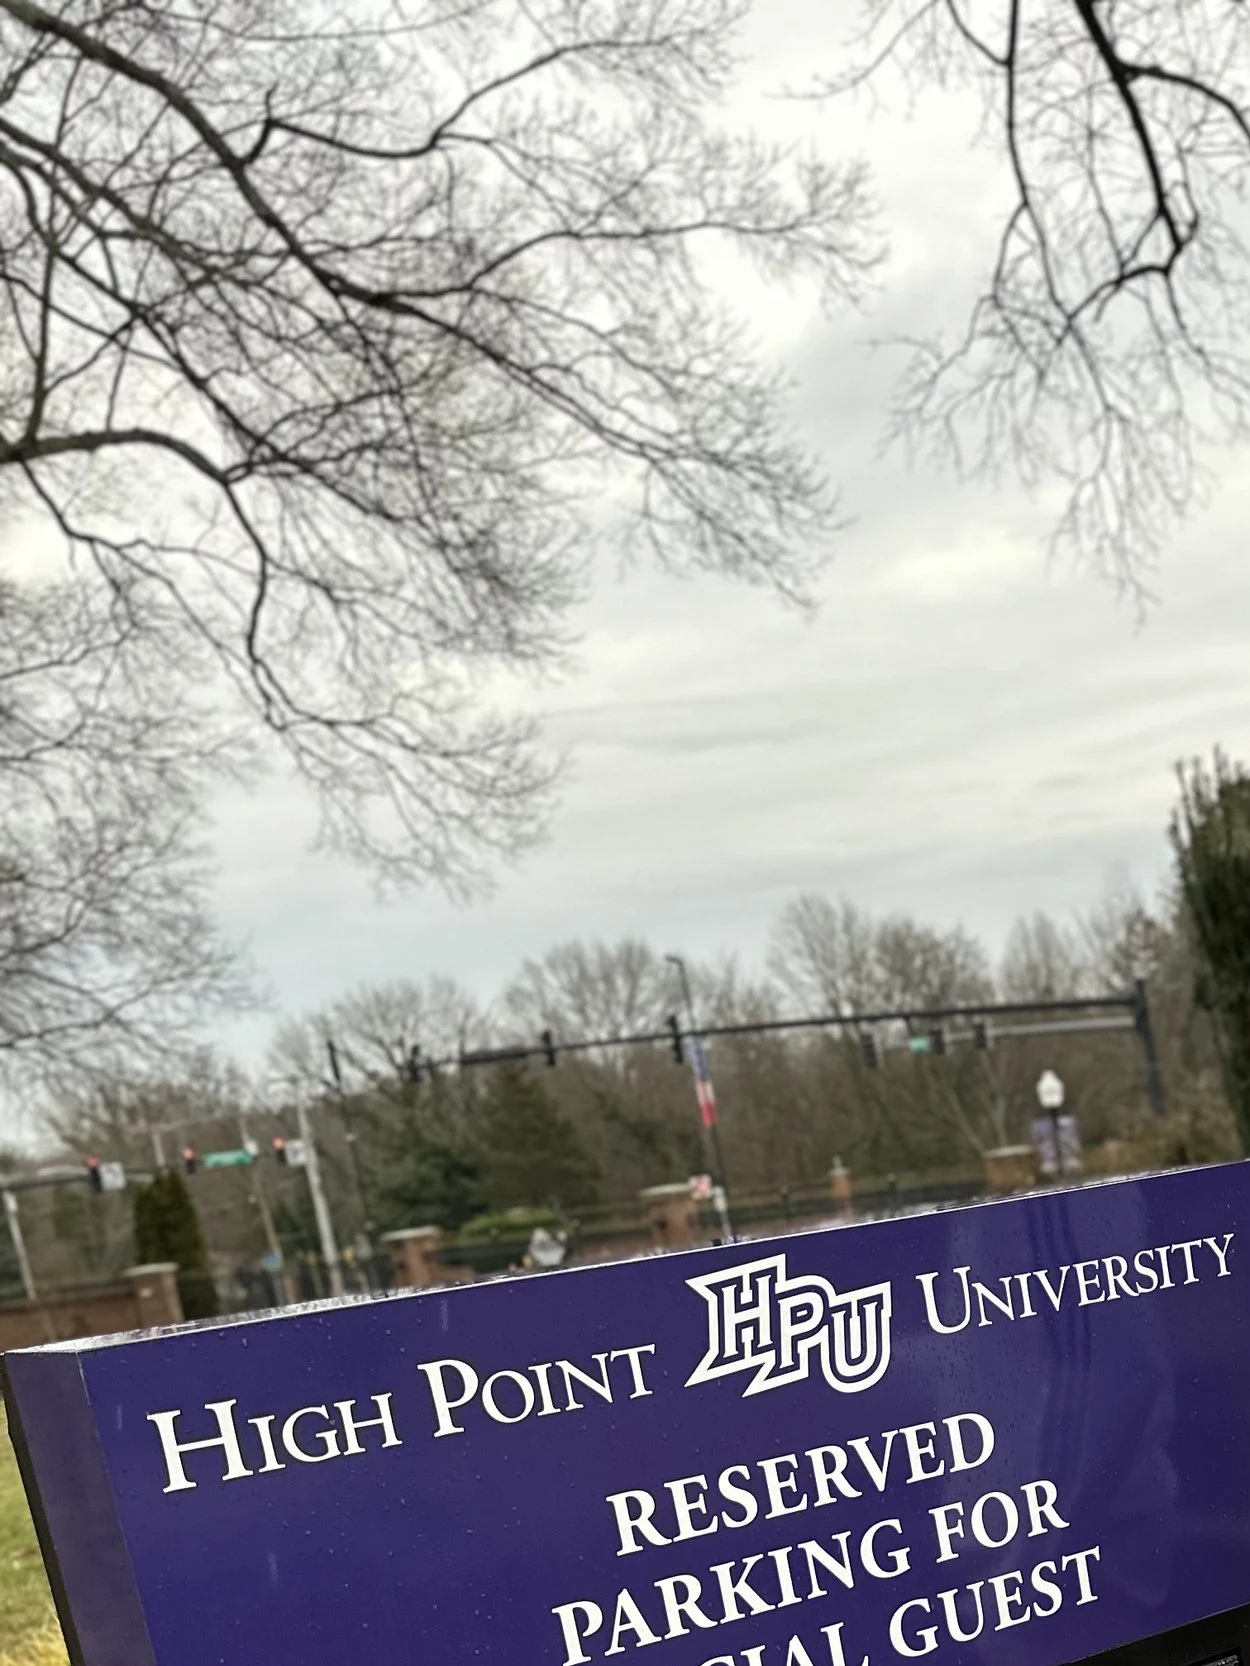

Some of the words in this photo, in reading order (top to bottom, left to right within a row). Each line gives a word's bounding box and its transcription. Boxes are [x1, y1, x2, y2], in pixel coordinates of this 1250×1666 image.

[146, 1392, 403, 1494] HIGH
[417, 1343, 656, 1438] POINT
[688, 1257, 891, 1397] HPU
[915, 1233, 1235, 1334] UNIVERSITY
[605, 1413, 995, 1557] RESERVED
[928, 1480, 1070, 1564] FOR
[889, 1545, 1100, 1658] GUEST
